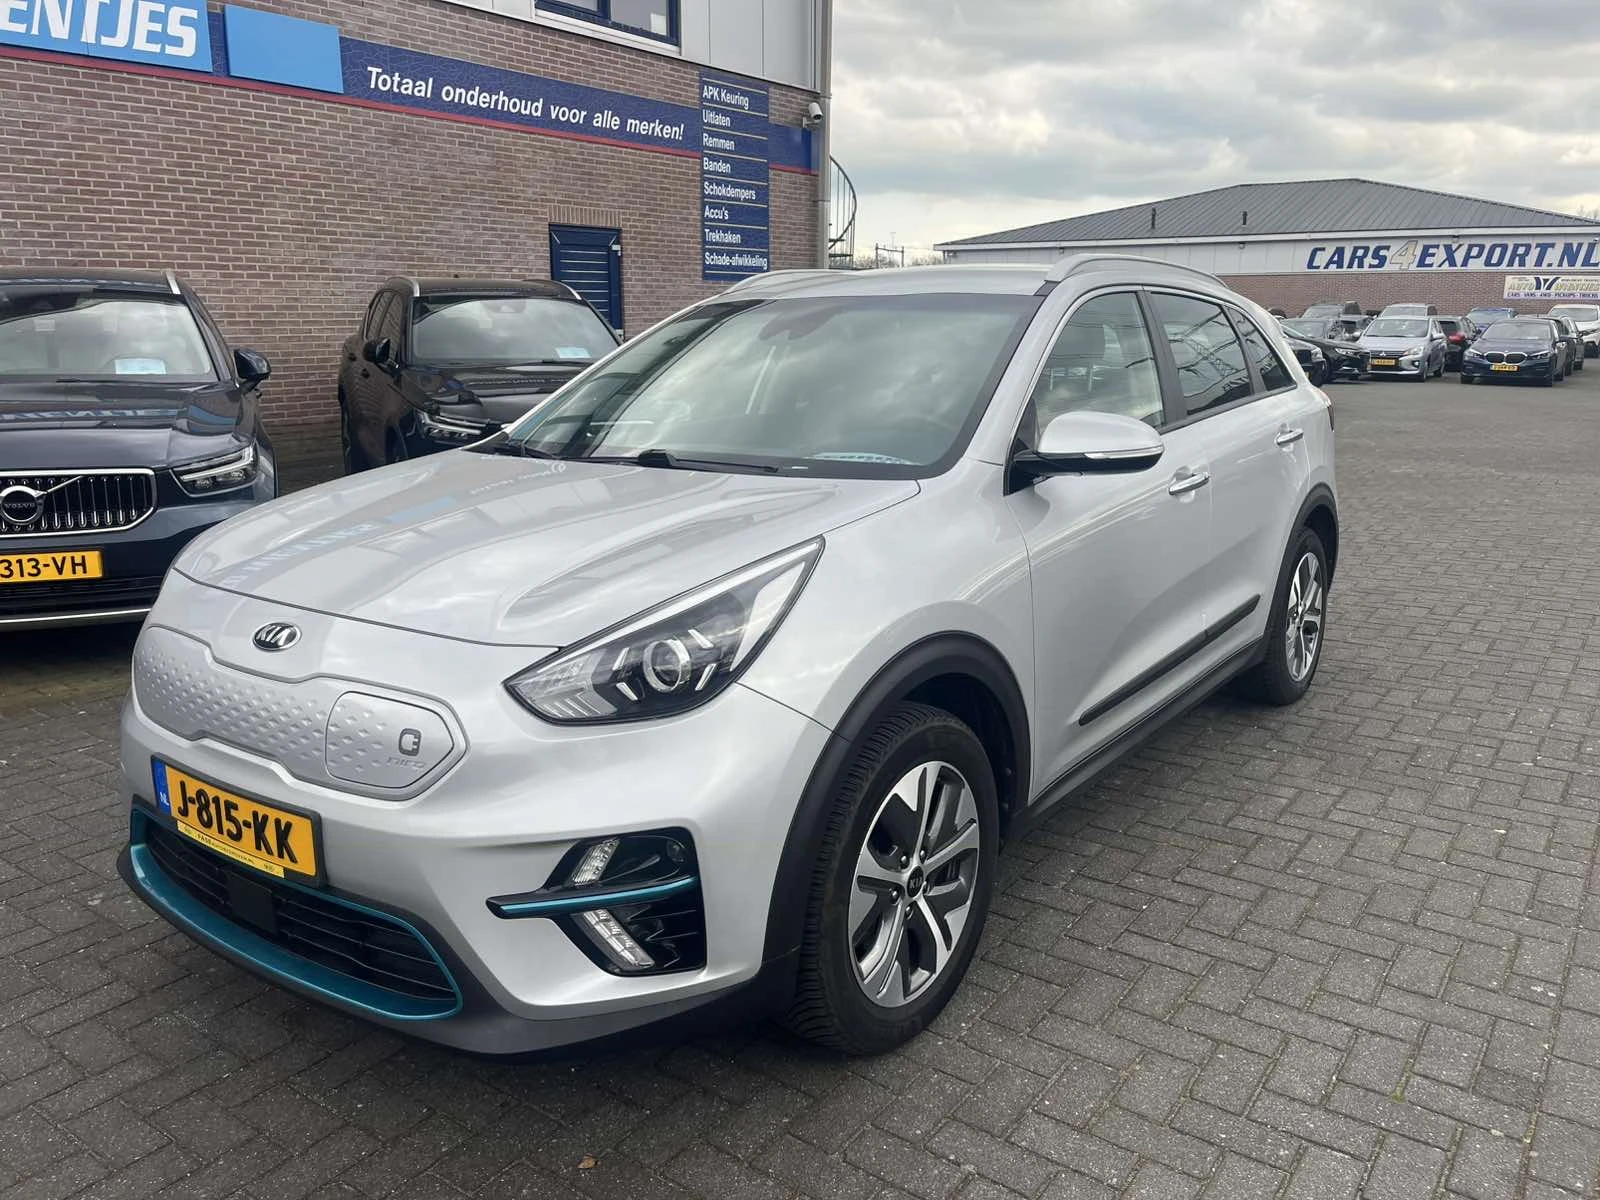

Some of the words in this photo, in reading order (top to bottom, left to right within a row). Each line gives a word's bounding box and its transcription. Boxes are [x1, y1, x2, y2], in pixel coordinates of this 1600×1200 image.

[367, 66, 433, 98] Totaal
[441, 85, 543, 118] onderhoud
[550, 104, 587, 124] voor
[593, 109, 620, 131] alle
[626, 119, 685, 141] merken!
[702, 85, 720, 102] APK
[721, 88, 750, 110] Keuring
[702, 109, 731, 128] Uitlaten
[703, 133, 735, 151] Remmen
[703, 157, 731, 173] Banden
[704, 181, 756, 201] Schokdempers
[704, 205, 729, 220] Accu's
[704, 229, 741, 244] Trekhaken
[705, 252, 768, 270] Schade-afwikkeling
[177, 780, 298, 864] J-815-KK
